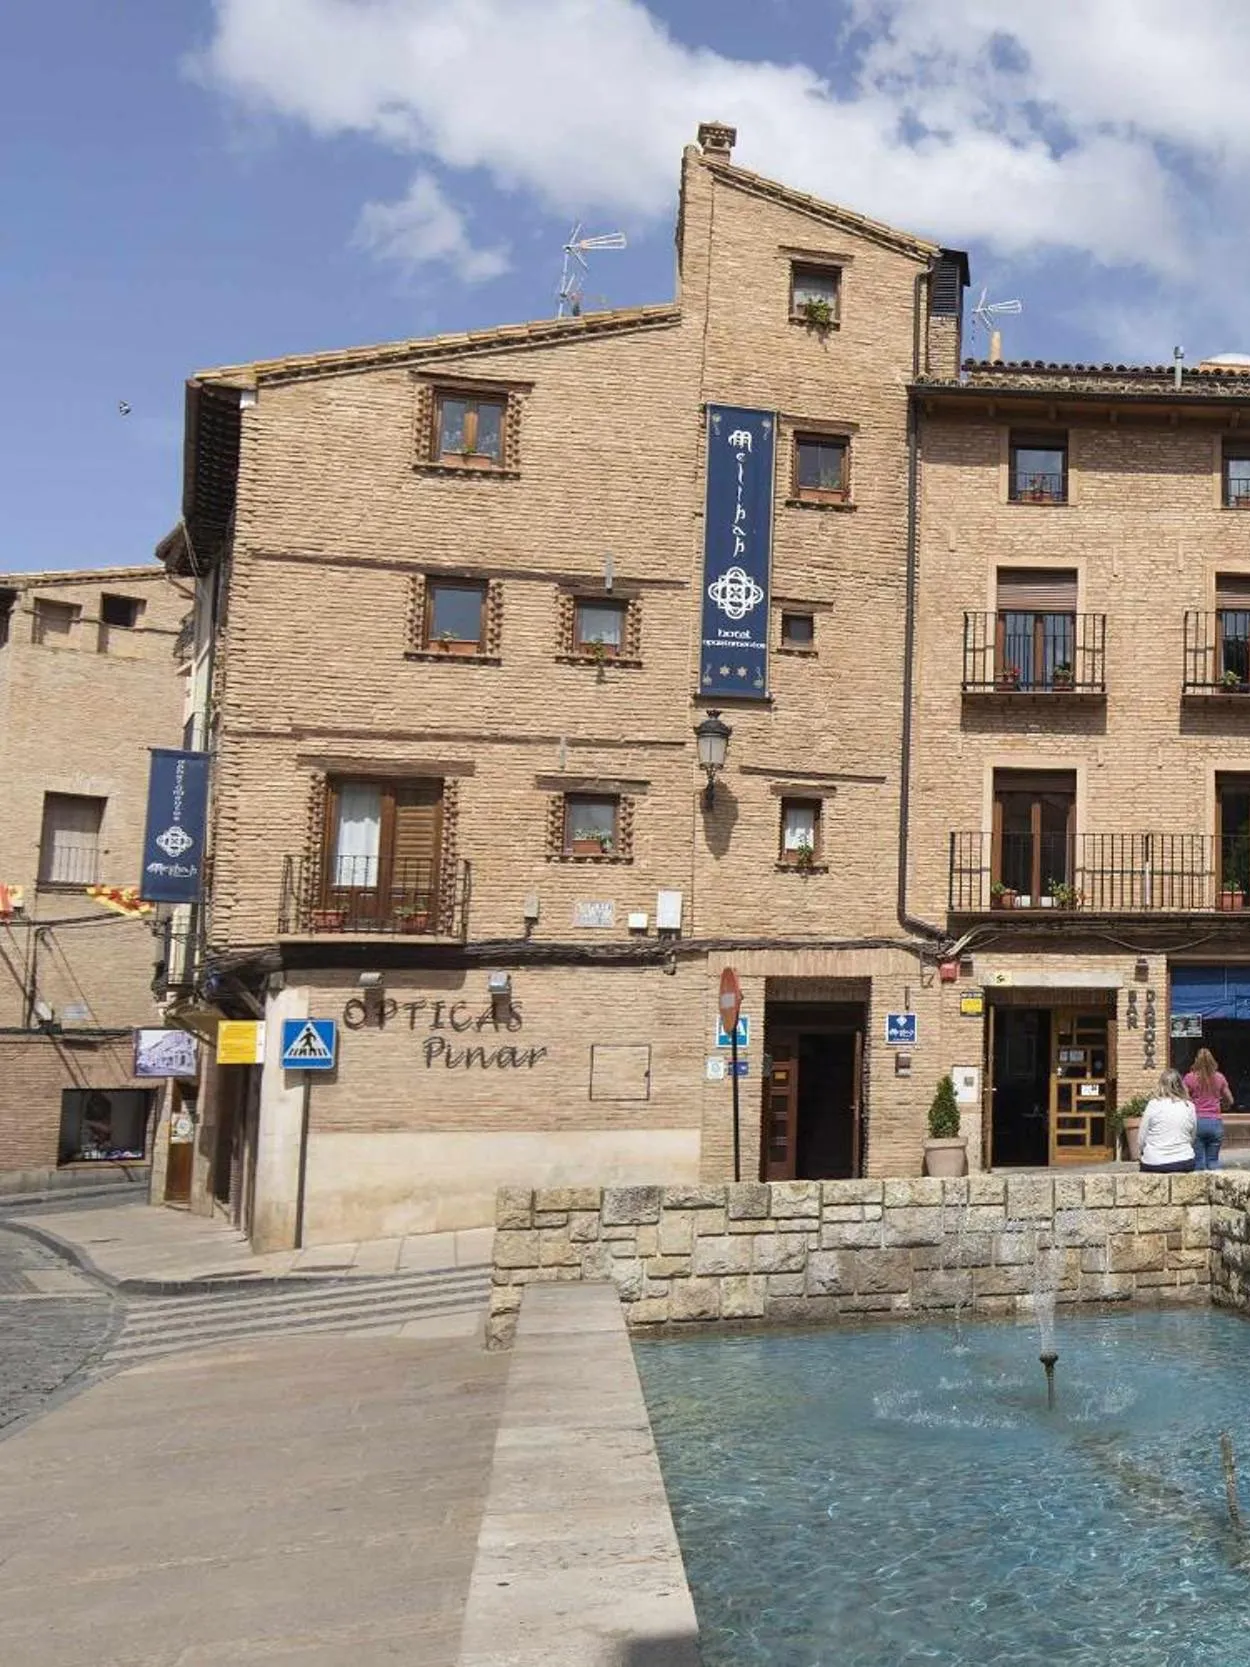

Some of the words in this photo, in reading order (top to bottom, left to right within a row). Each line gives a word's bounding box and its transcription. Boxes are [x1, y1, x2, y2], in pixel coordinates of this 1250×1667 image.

[343, 998, 523, 1033] OPTICAS
[1126, 990, 1138, 1030] BAR
[1144, 989, 1156, 1070] DAROCA
[422, 1036, 548, 1070] Pinar
